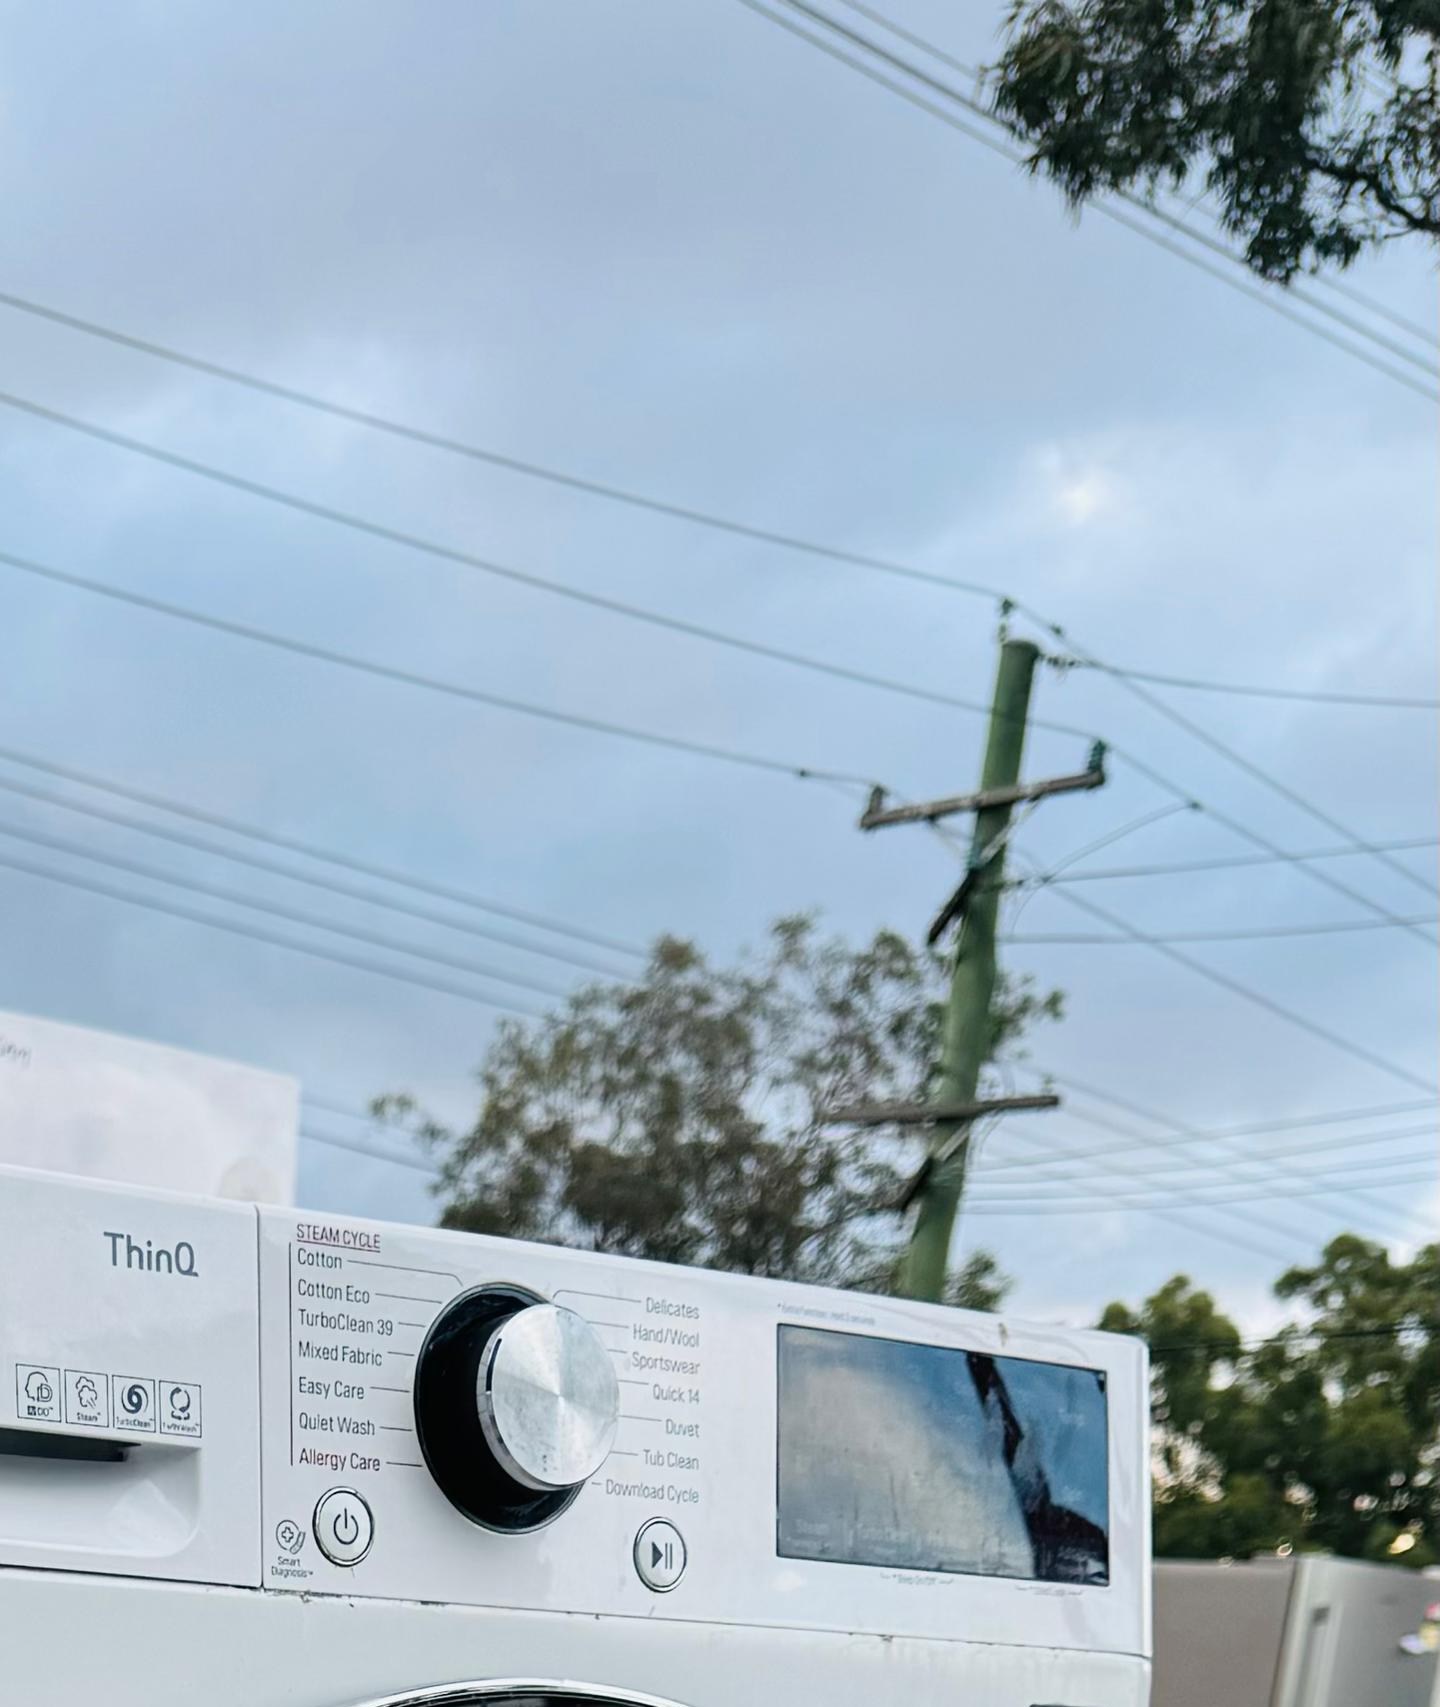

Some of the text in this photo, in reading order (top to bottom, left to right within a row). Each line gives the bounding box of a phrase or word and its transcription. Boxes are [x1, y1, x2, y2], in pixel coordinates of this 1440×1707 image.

[297, 1223, 380, 1249] STEAM CYCLE
[103, 1231, 199, 1278] ThinQ
[297, 1247, 342, 1269] Cotton
[298, 1278, 370, 1304] Cotton Eco
[646, 1297, 699, 1319] Delicates
[298, 1308, 393, 1336] TurboClean 39
[633, 1323, 699, 1348] Hand/Wool
[299, 1340, 382, 1366] Mixed Fabric
[632, 1351, 700, 1374] Sportswear
[299, 1376, 364, 1399] Easy Care
[652, 1384, 700, 1405] Quick 14
[299, 1412, 375, 1435] Quiet Wash
[665, 1418, 700, 1439] Duvet
[299, 1447, 380, 1472] Allergy Care
[643, 1448, 699, 1470] Tub Clean
[606, 1479, 700, 1504] Download Cycle
